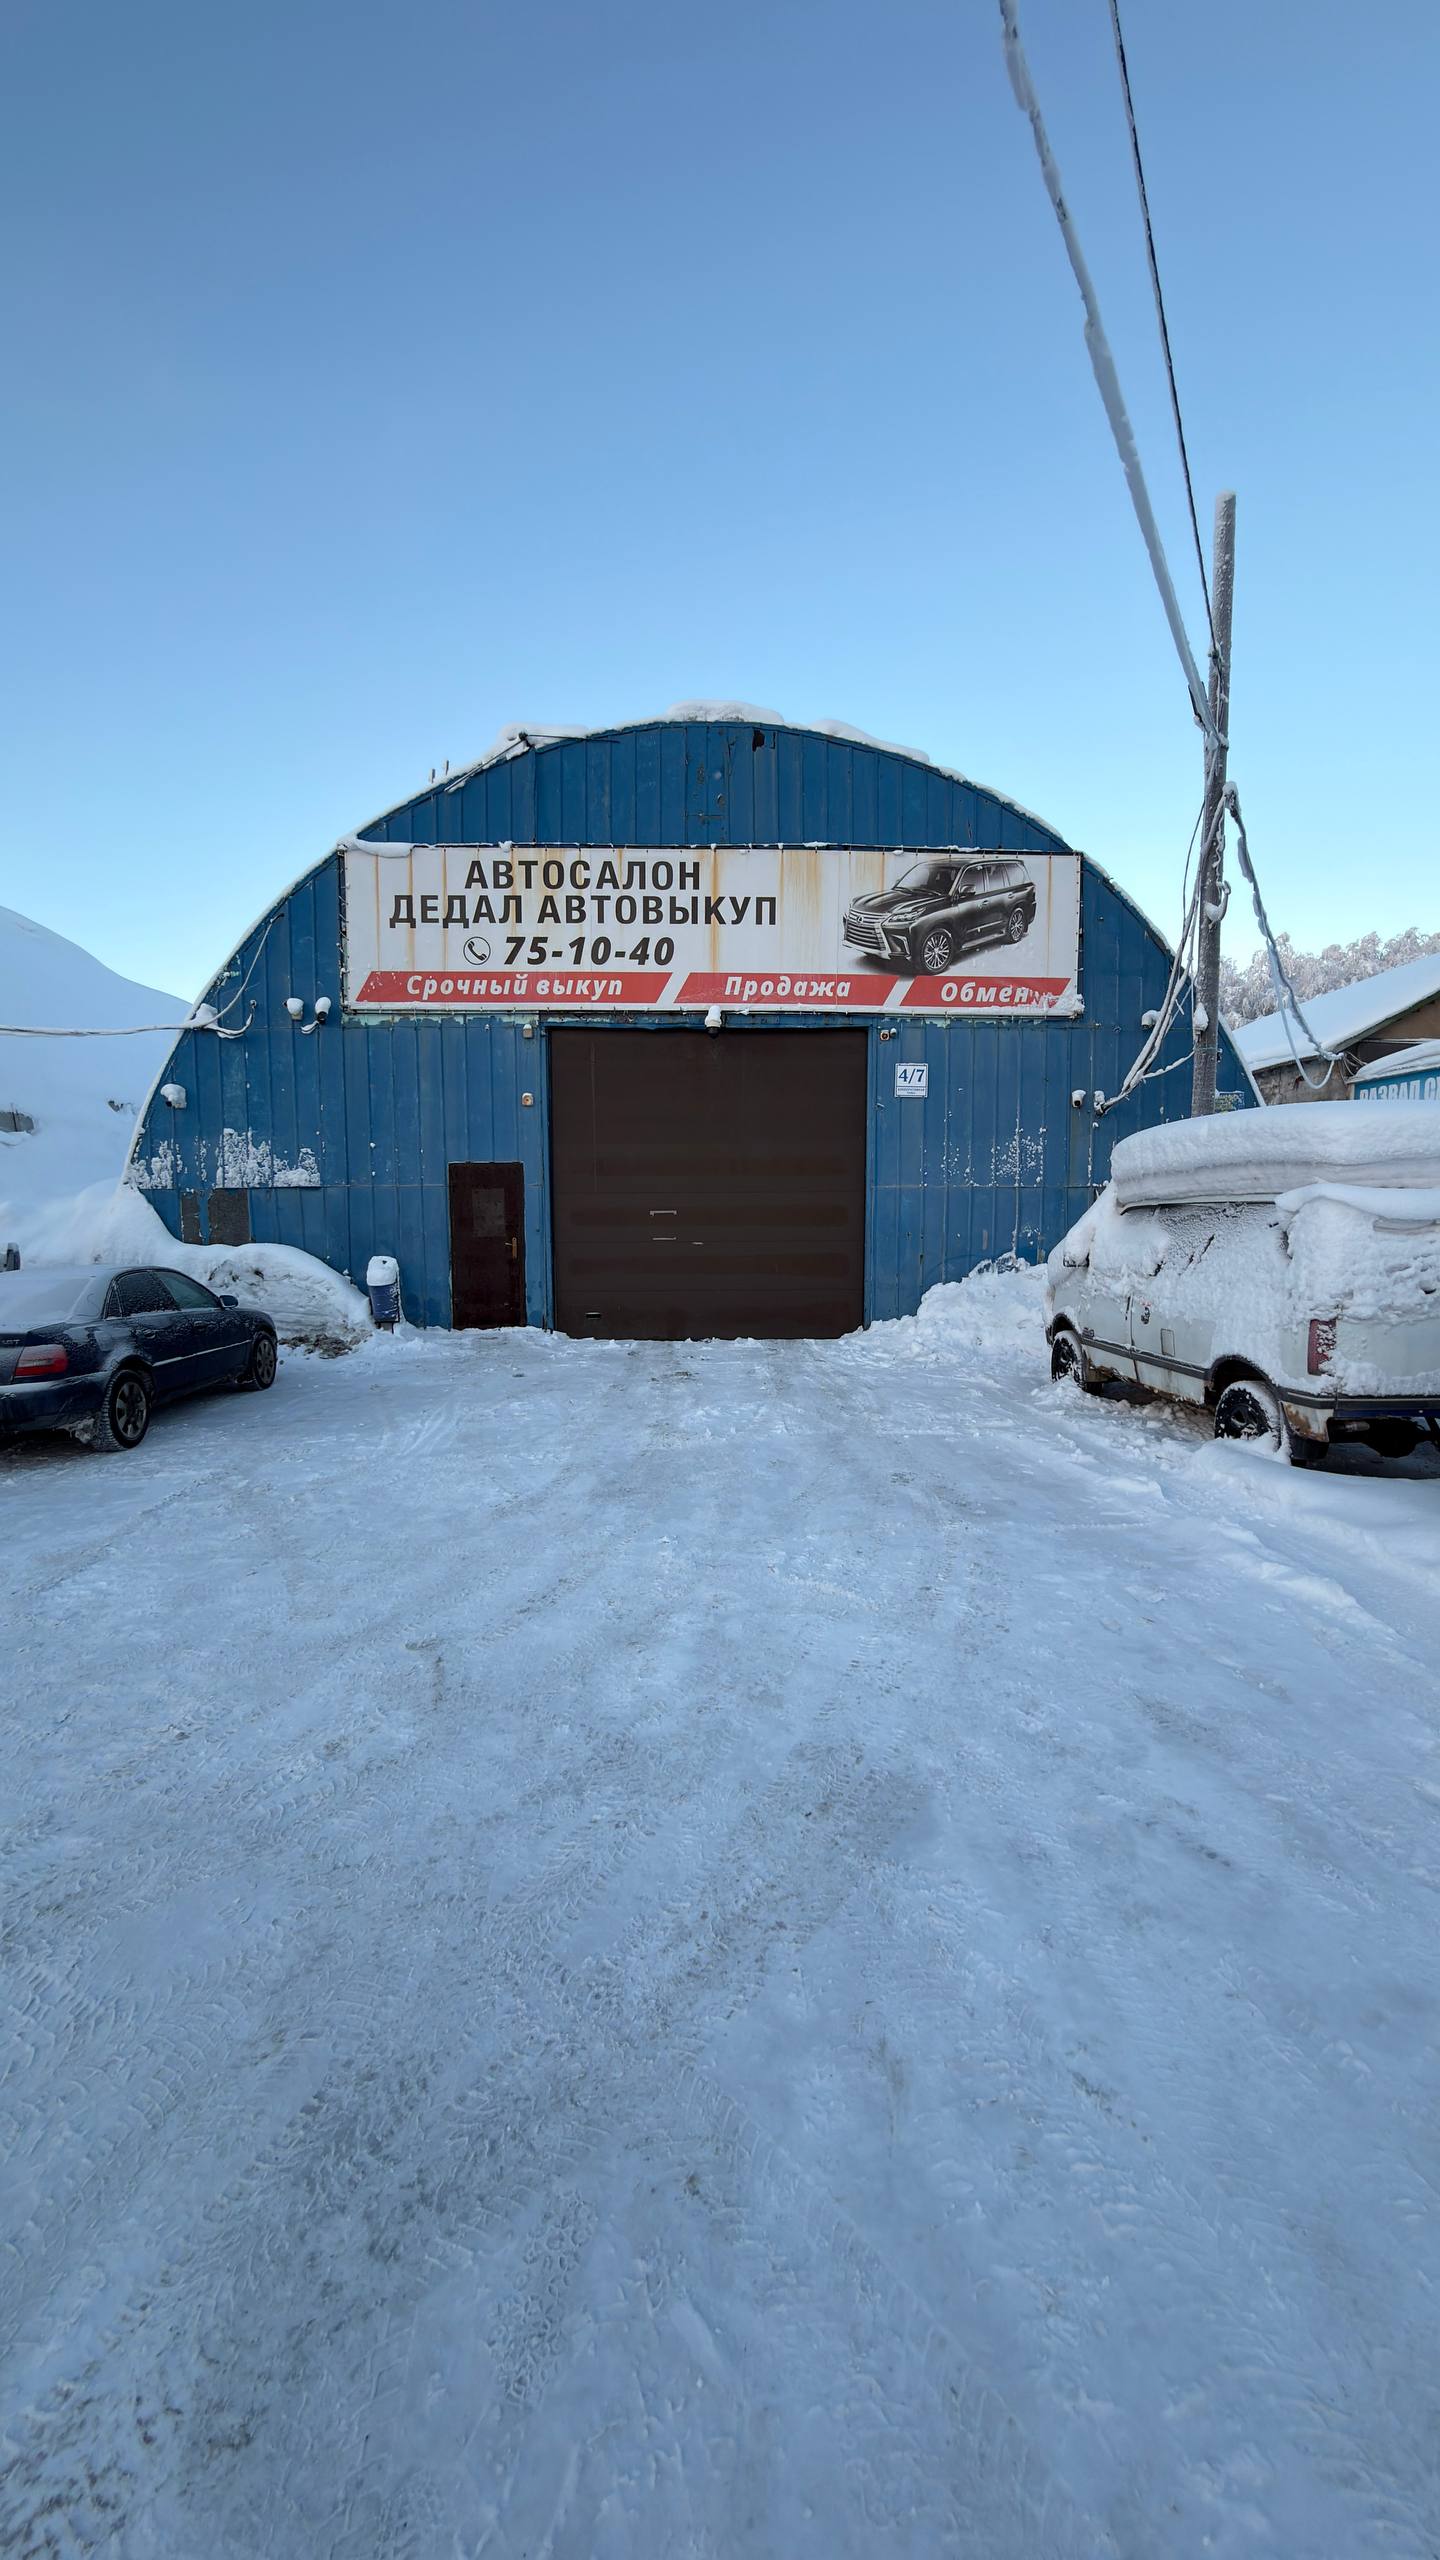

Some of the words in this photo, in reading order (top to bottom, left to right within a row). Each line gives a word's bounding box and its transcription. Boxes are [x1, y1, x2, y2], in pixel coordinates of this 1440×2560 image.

[464, 860, 700, 890] АВТОСАЛОН
[389, 895, 523, 928] ДЕДАЛ
[537, 895, 777, 925] АВТОВЫКУП
[504, 936, 675, 966] 75-10-40
[406, 973, 529, 1000] Срочный
[536, 978, 624, 1000] выкуп
[724, 975, 852, 1001] Продажа
[940, 981, 1030, 1005] Обмен
[898, 1068, 926, 1084] 4/7
